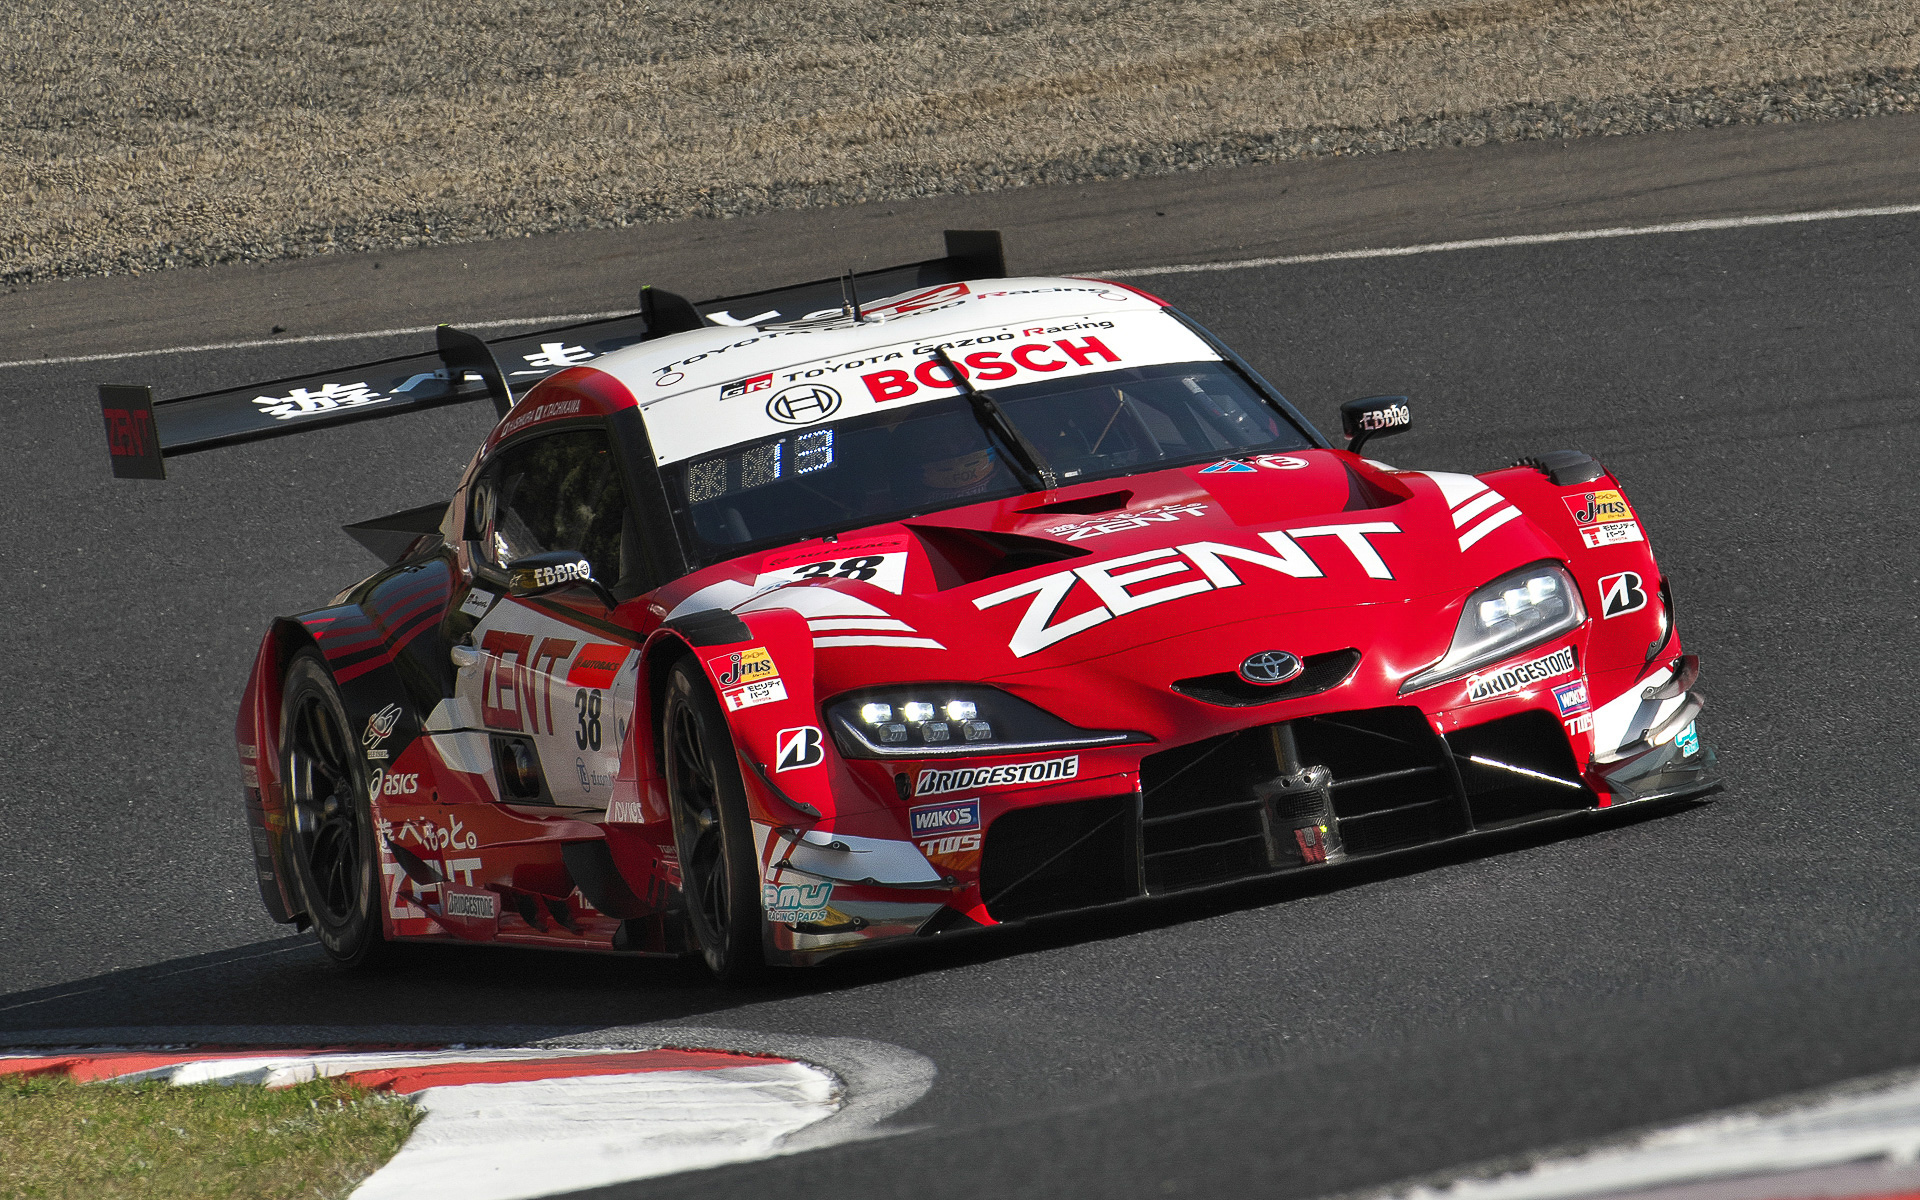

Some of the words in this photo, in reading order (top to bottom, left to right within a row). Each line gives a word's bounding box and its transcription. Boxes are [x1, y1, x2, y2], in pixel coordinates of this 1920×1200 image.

[782, 350, 904, 382] TOYOTA
[912, 332, 1015, 356] GAZOO
[1022, 319, 1115, 338] Racing
[861, 336, 1122, 403] BOSCH
[1054, 505, 1209, 542] ZENT
[534, 560, 591, 587] EBBRO
[971, 521, 1405, 659] ZENT
[481, 629, 578, 736] ZENT
[1467, 646, 1575, 702] BRIDGESTONE
[575, 688, 602, 752] 38
[384, 773, 419, 795] asics
[915, 755, 1079, 797] BRIDGESTONE
[919, 833, 982, 857] TWS
[446, 890, 495, 919] BRIDGESTONE
[768, 910, 795, 923] RACING
[796, 910, 828, 923] PADS
